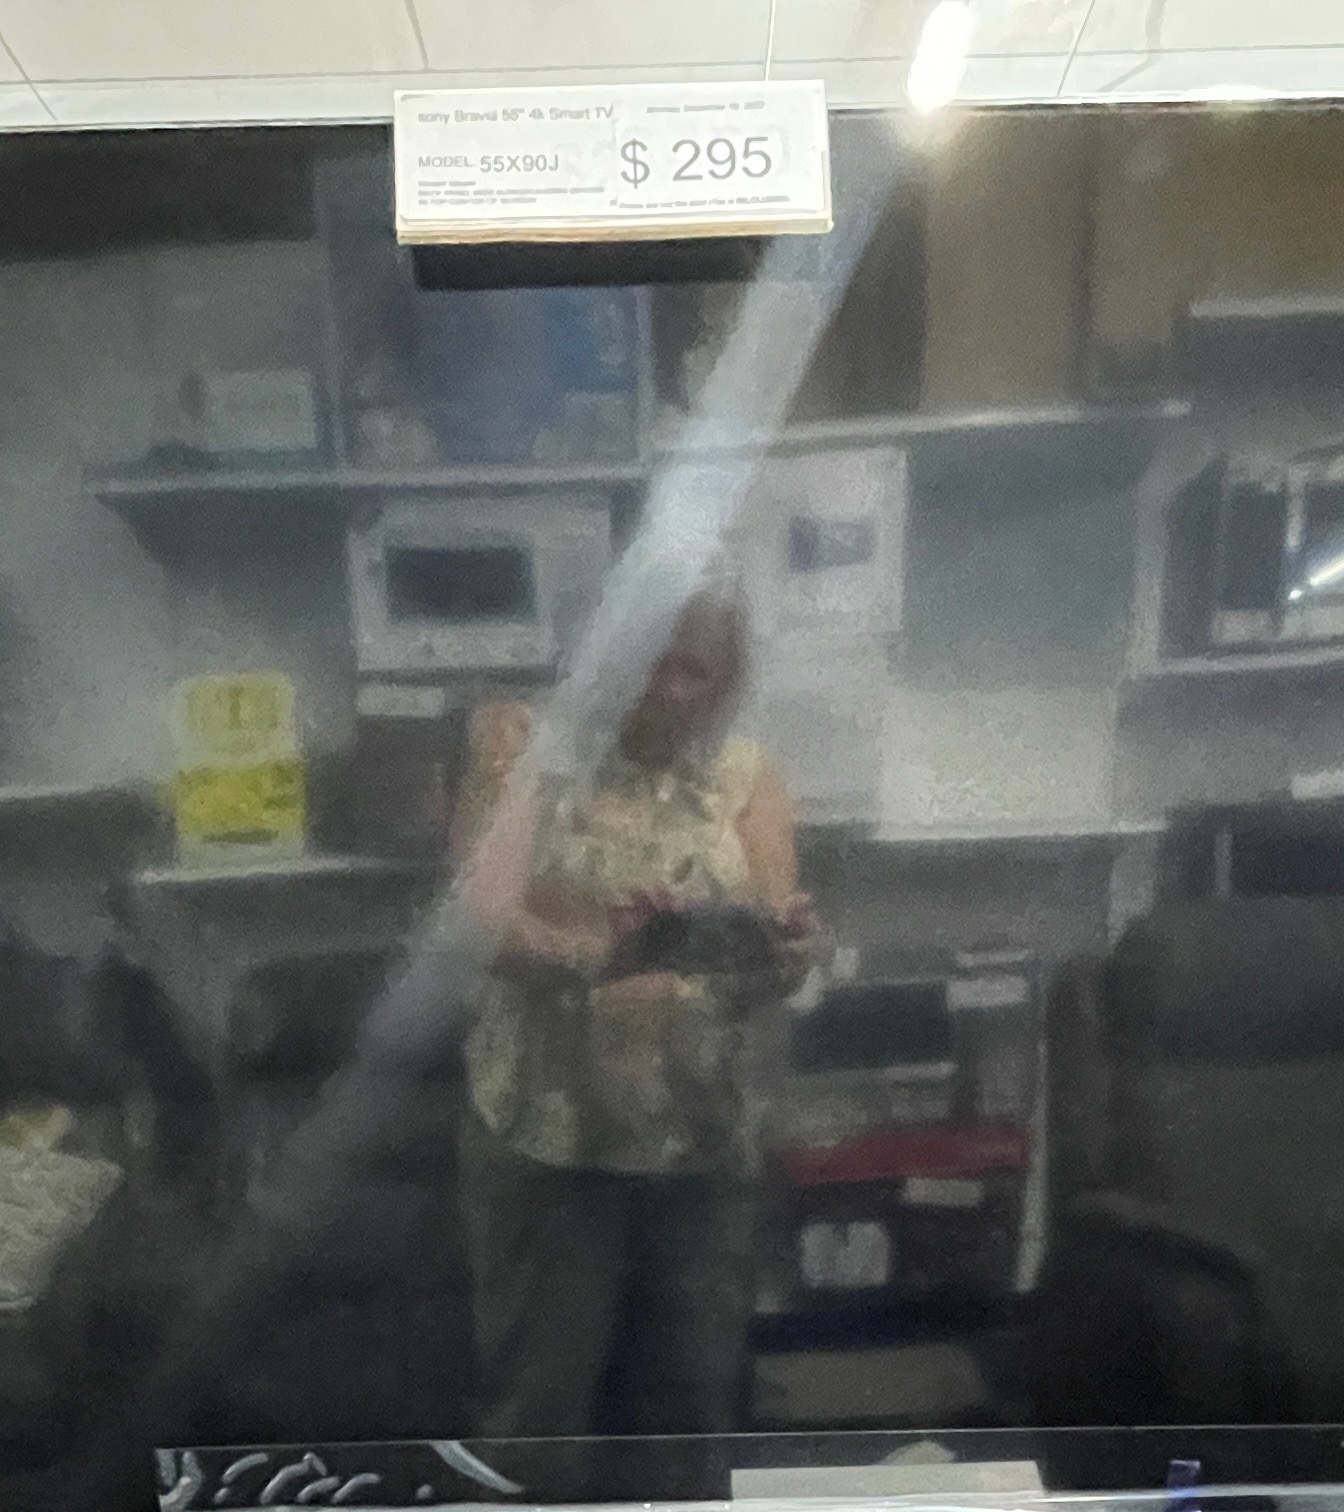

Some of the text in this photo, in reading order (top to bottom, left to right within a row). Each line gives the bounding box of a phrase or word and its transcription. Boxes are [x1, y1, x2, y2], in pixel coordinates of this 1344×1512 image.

[418, 154, 559, 172] MODEL 55X90J
[621, 136, 772, 189] $ 295
